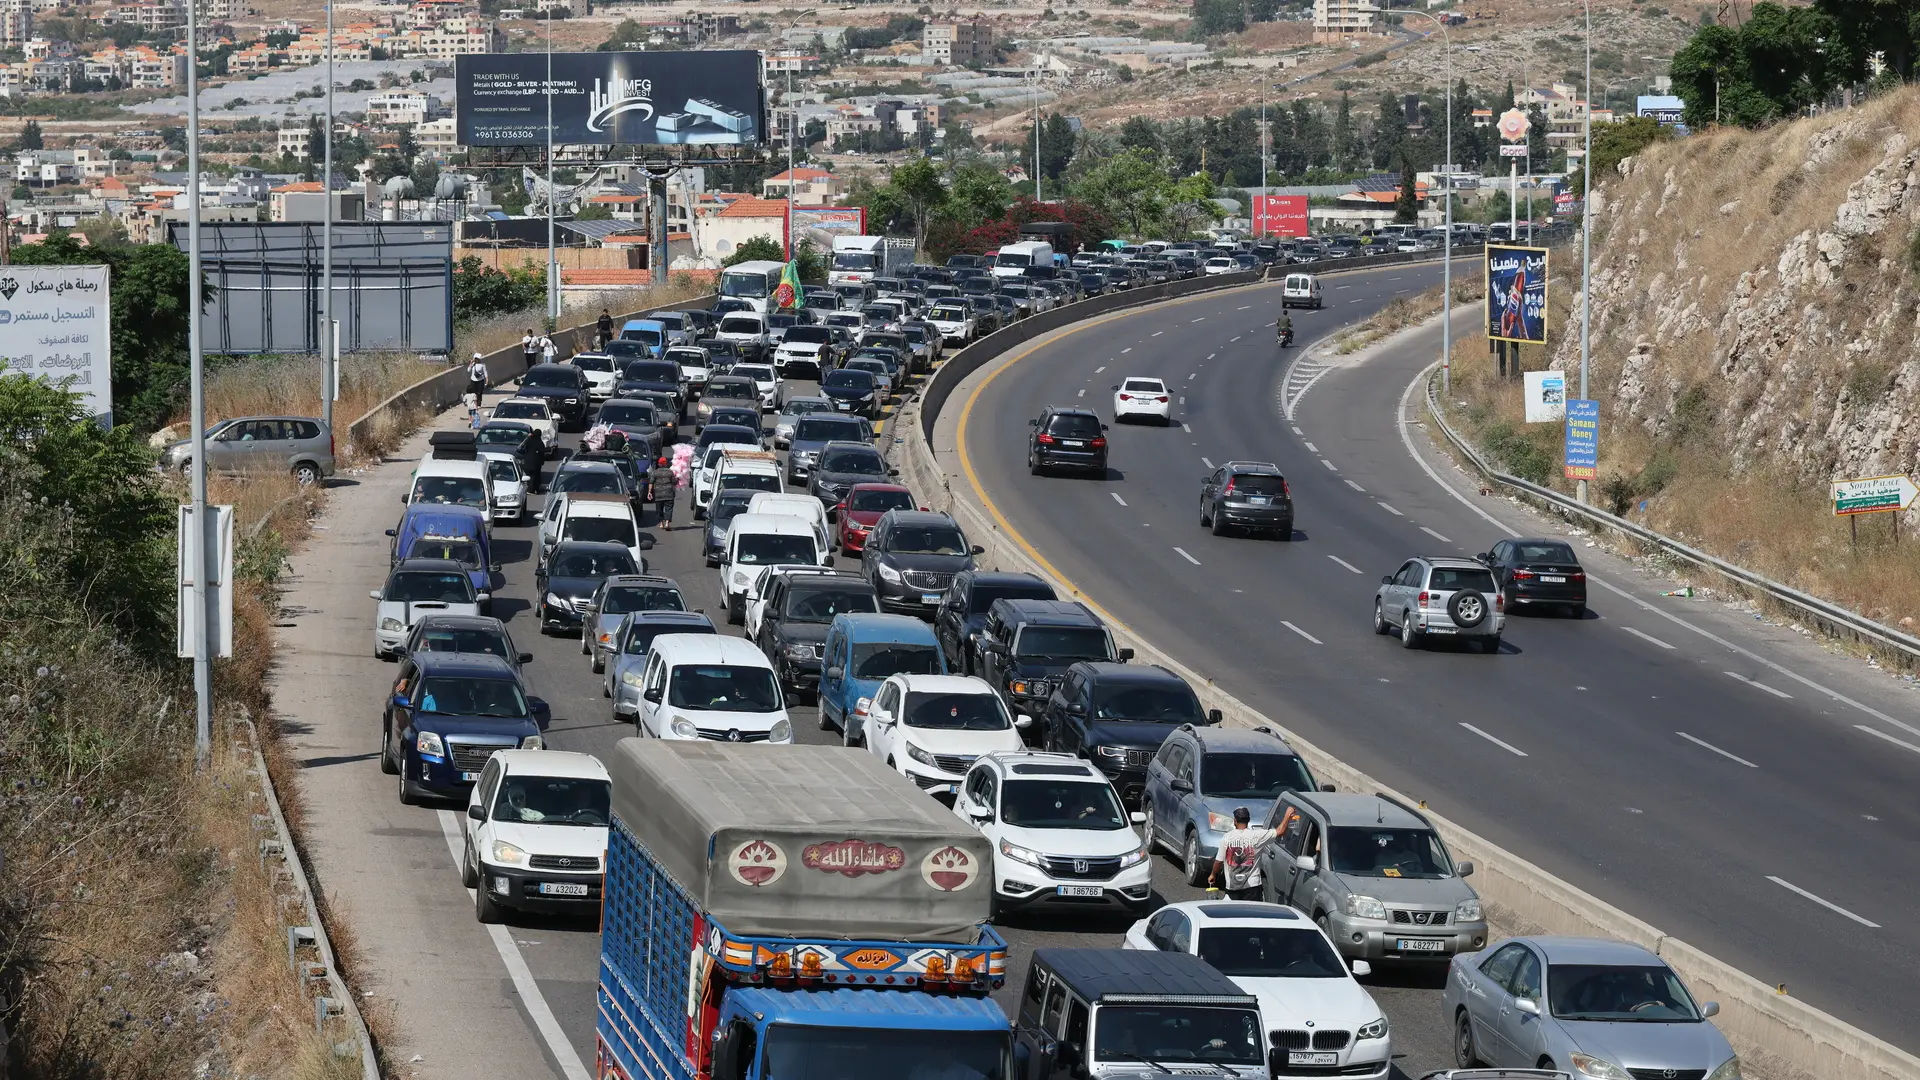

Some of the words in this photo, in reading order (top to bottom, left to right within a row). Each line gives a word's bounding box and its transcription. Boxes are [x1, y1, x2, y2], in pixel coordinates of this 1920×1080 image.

[624, 79, 651, 90] MFG
[1501, 147, 1527, 155] Coral
[27, 280, 53, 294] سكول
[56, 279, 73, 296] هاي
[76, 278, 98, 292] رميلة
[14, 310, 49, 324] مستمر
[52, 307, 95, 323] التسجيل
[72, 334, 88, 343] لكافة
[1569, 417, 1596, 428] Samana
[1571, 428, 1592, 440] Honey
[1878, 487, 1900, 495] سوفيا
[822, 846, 852, 866] الله
[854, 846, 884, 866] ماشاء
[556, 886, 582, 894] 432024
[601, 955, 613, 972] HINO
[618, 978, 634, 1000] TURBO
[654, 1025, 673, 1052] MODEL
[680, 1059, 694, 1078] 2017
